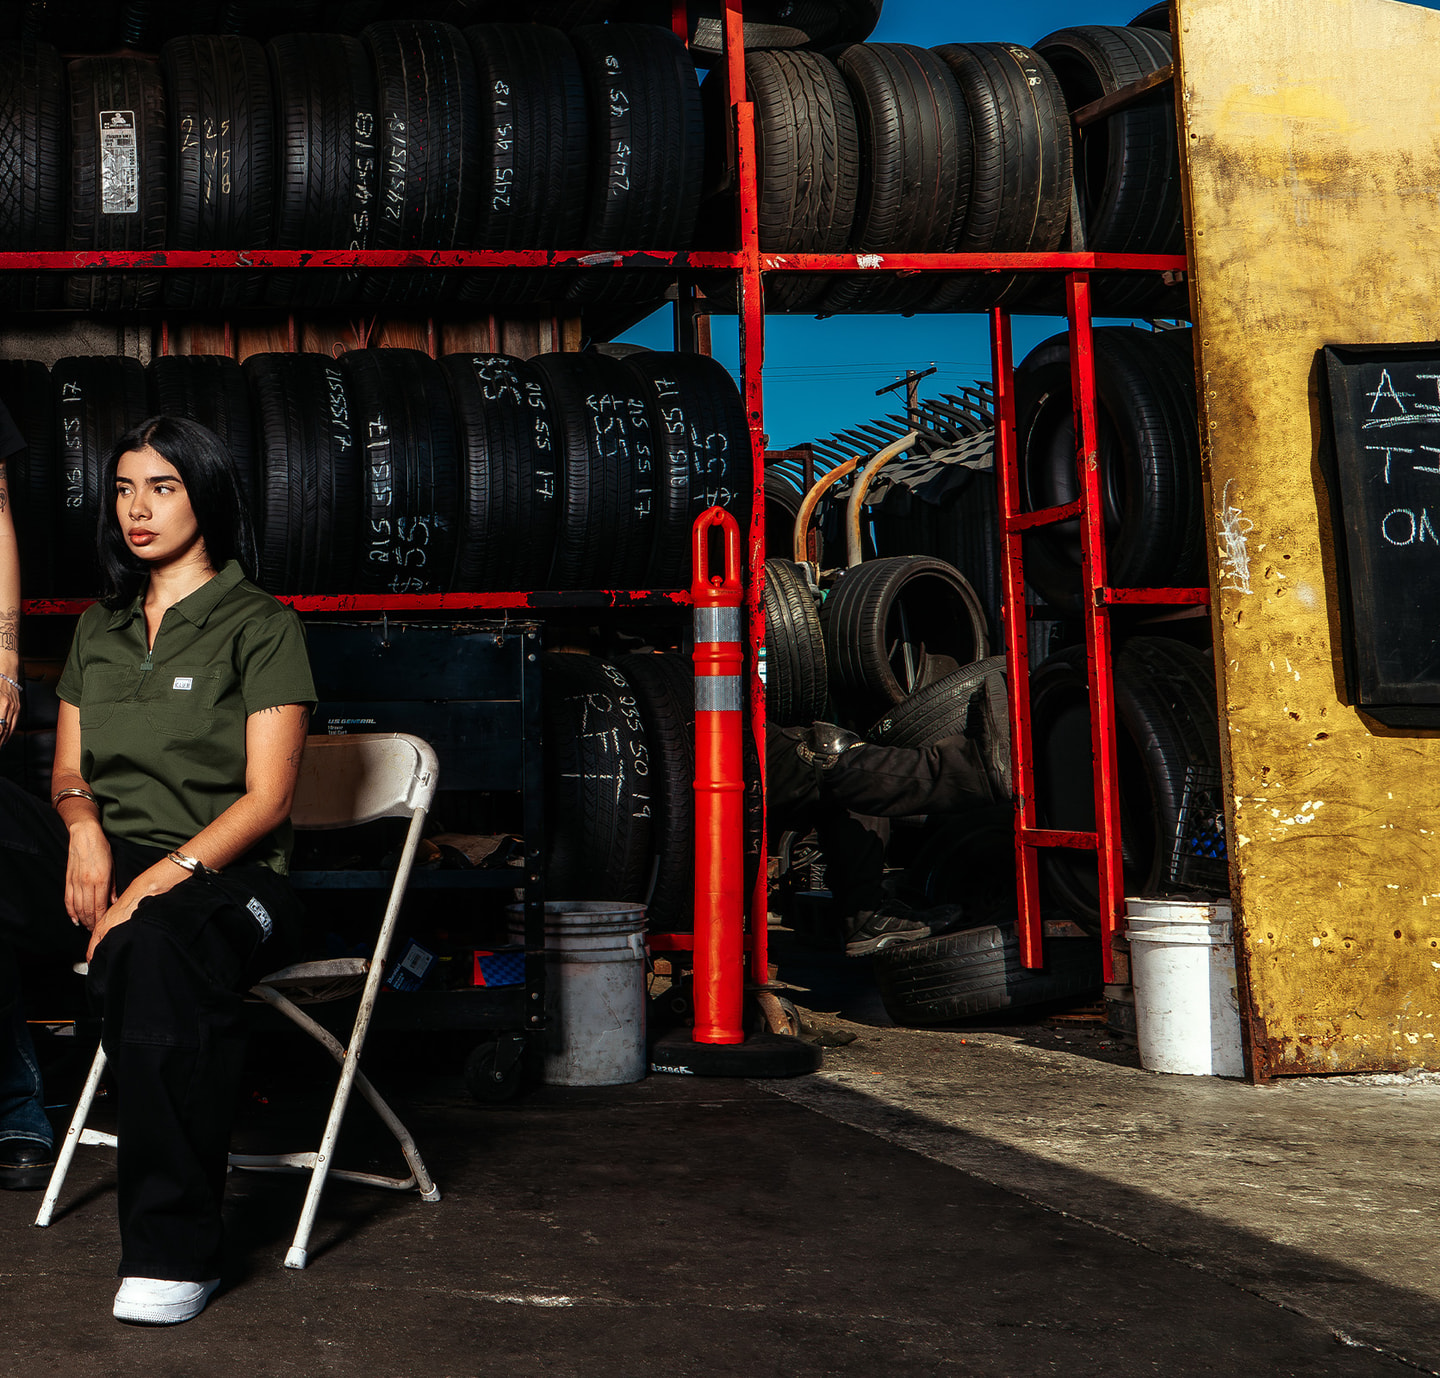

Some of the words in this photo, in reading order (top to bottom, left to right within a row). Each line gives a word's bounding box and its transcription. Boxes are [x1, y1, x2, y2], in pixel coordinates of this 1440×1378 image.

[62, 381, 82, 402] 17
[630, 740, 650, 776] 50
[631, 793, 652, 818] 19
